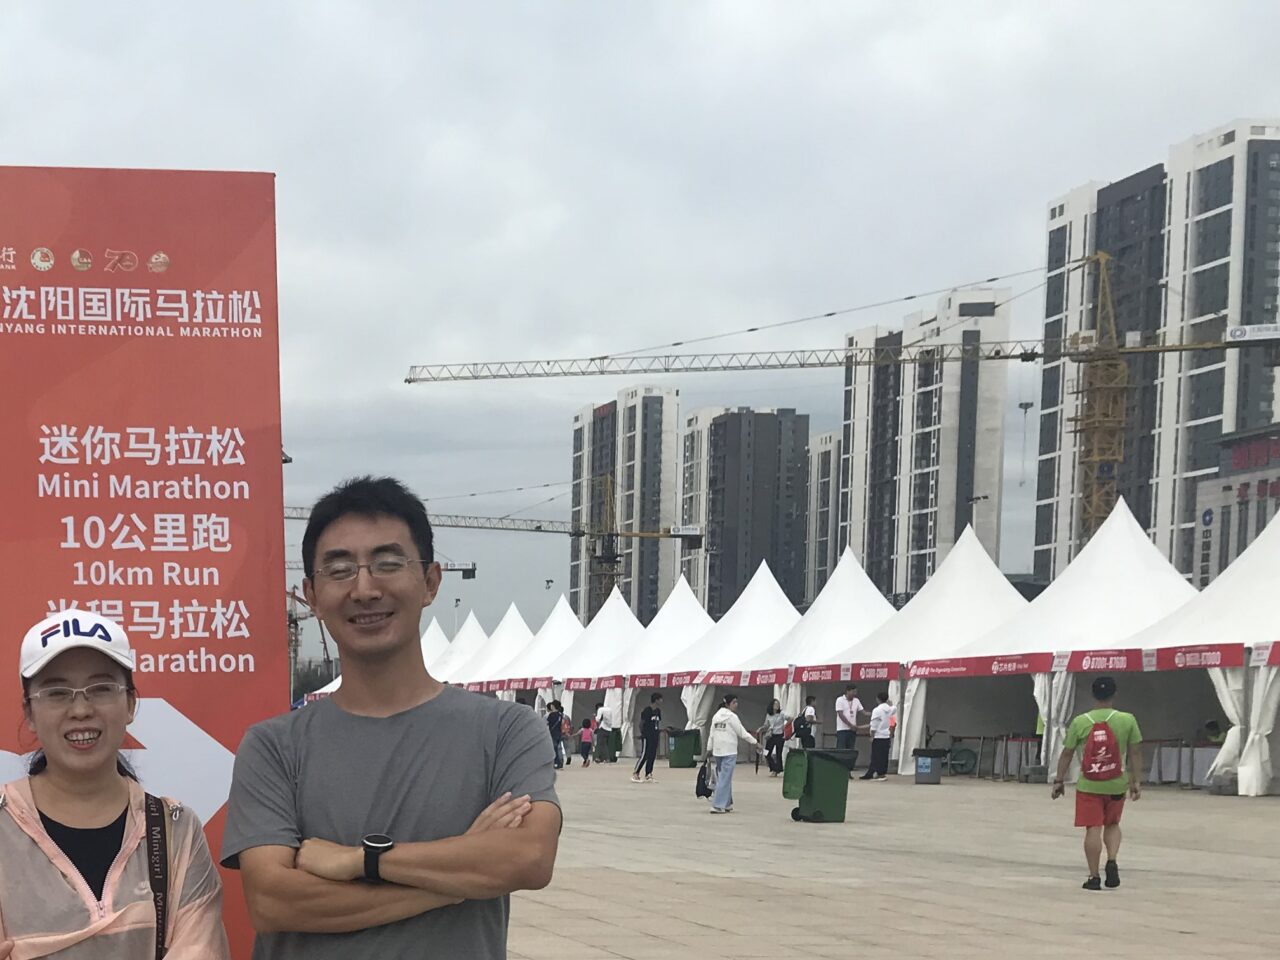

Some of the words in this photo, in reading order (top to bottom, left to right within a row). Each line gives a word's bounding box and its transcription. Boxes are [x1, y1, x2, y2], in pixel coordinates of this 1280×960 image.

[51, 324, 174, 337] INTERNATIONAL
[180, 326, 262, 338] MARATHON
[38, 424, 246, 466] 迷你马拉松
[38, 472, 99, 498] Mini
[109, 474, 250, 500] Marathon
[60, 513, 232, 552] 10公里跑
[73, 560, 153, 586] 10km
[163, 562, 220, 586] Run
[40, 618, 112, 648] FILA
[151, 826, 163, 879] Minigirl
